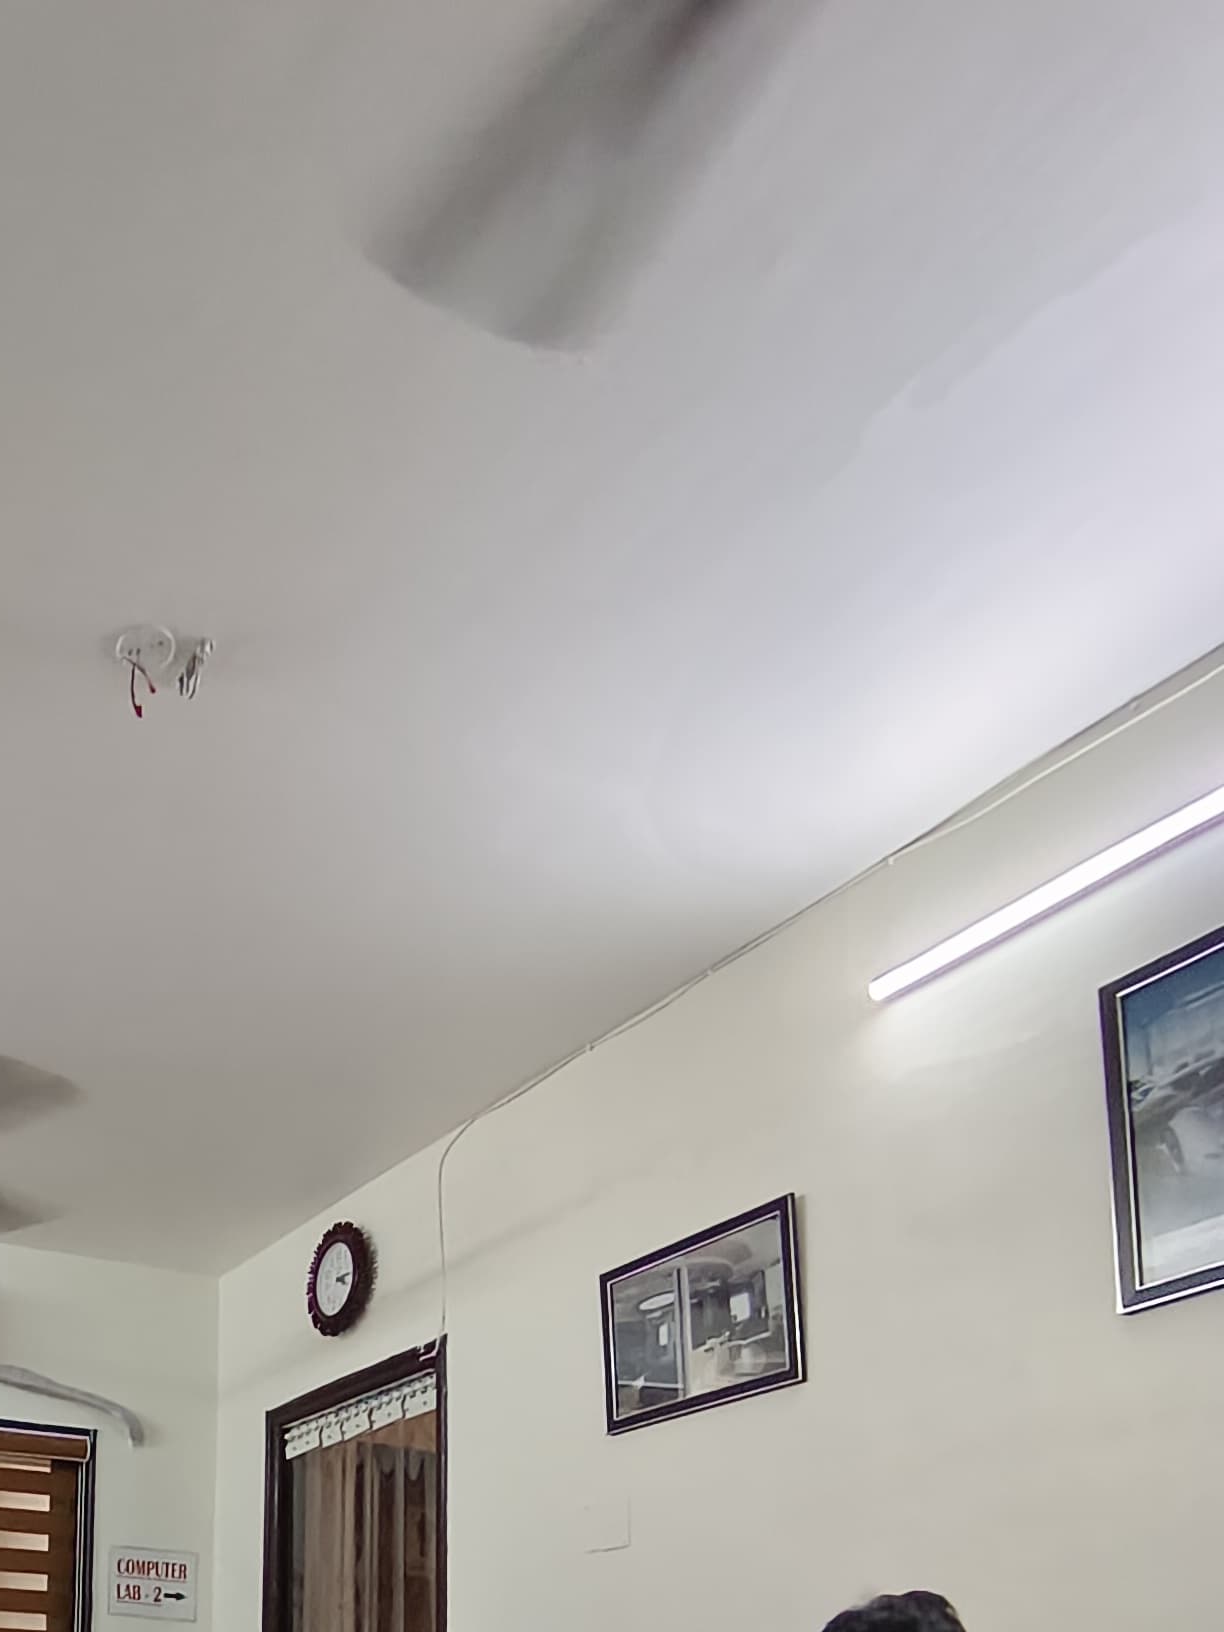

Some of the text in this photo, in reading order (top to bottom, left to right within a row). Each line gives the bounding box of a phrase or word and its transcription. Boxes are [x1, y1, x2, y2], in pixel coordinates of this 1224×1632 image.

[117, 1558, 187, 1580] COMPUTER
[116, 1583, 141, 1601] LAB
[153, 1586, 162, 1603] 2
